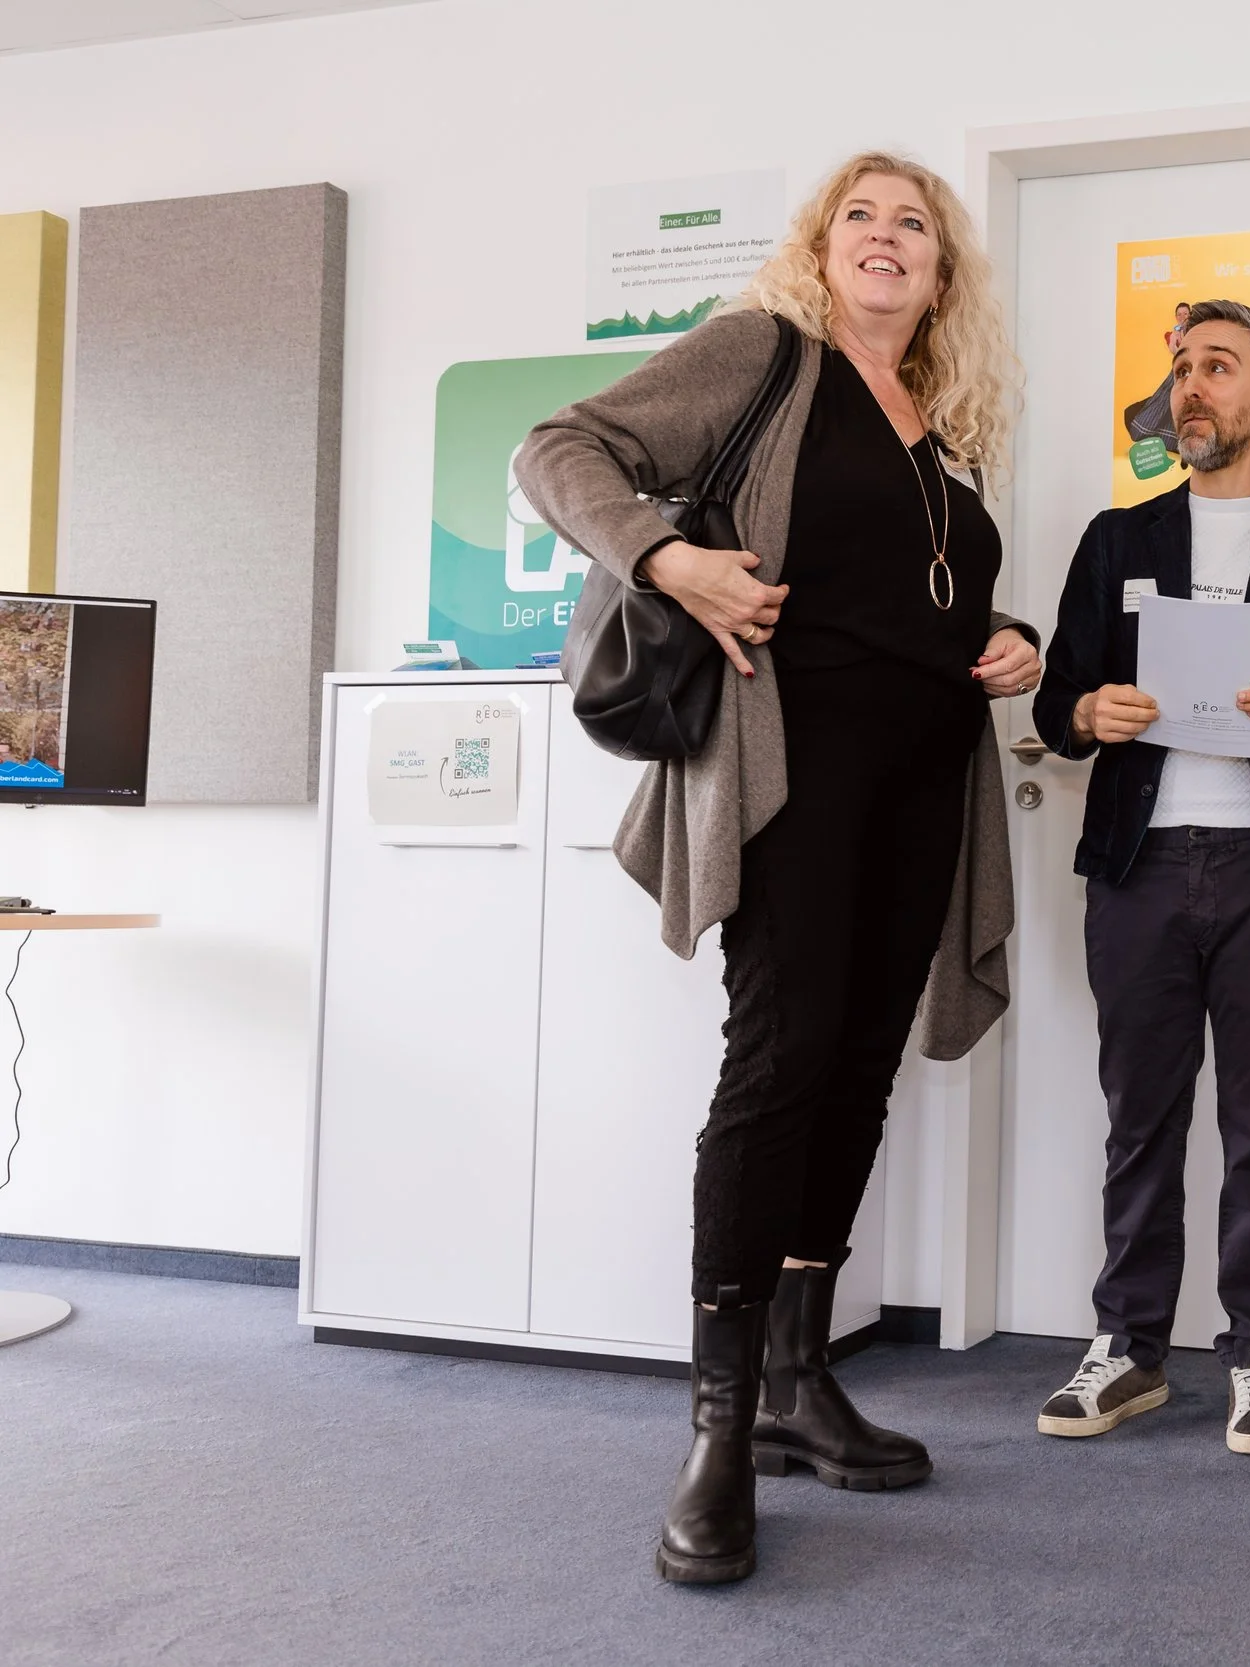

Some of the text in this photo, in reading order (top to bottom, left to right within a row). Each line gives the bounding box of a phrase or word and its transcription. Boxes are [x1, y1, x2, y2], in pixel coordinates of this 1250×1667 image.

[660, 213, 721, 228] Einer. Für Alle.
[612, 251, 625, 259] Hier
[626, 247, 656, 257] erhältlich
[660, 246, 672, 255] das
[672, 244, 693, 253] ideale
[693, 241, 724, 251] Geschenk
[738, 239, 750, 247] der
[750, 237, 774, 247] Region
[612, 266, 623, 274] Mit
[623, 263, 657, 273] beliebigem
[658, 261, 674, 270] Wert
[674, 258, 703, 269] zwischen
[709, 256, 722, 265] und
[723, 255, 736, 264] 100
[621, 280, 631, 288] Bei
[631, 278, 647, 288] allen
[648, 274, 691, 286] Partnerstellen
[691, 274, 700, 282] im
[700, 270, 731, 282] Landkreis
[1191, 583, 1244, 596] PALAIS DE VILLE
[503, 601, 547, 629] Der
[0, 775, 59, 783] berlandcard.com
